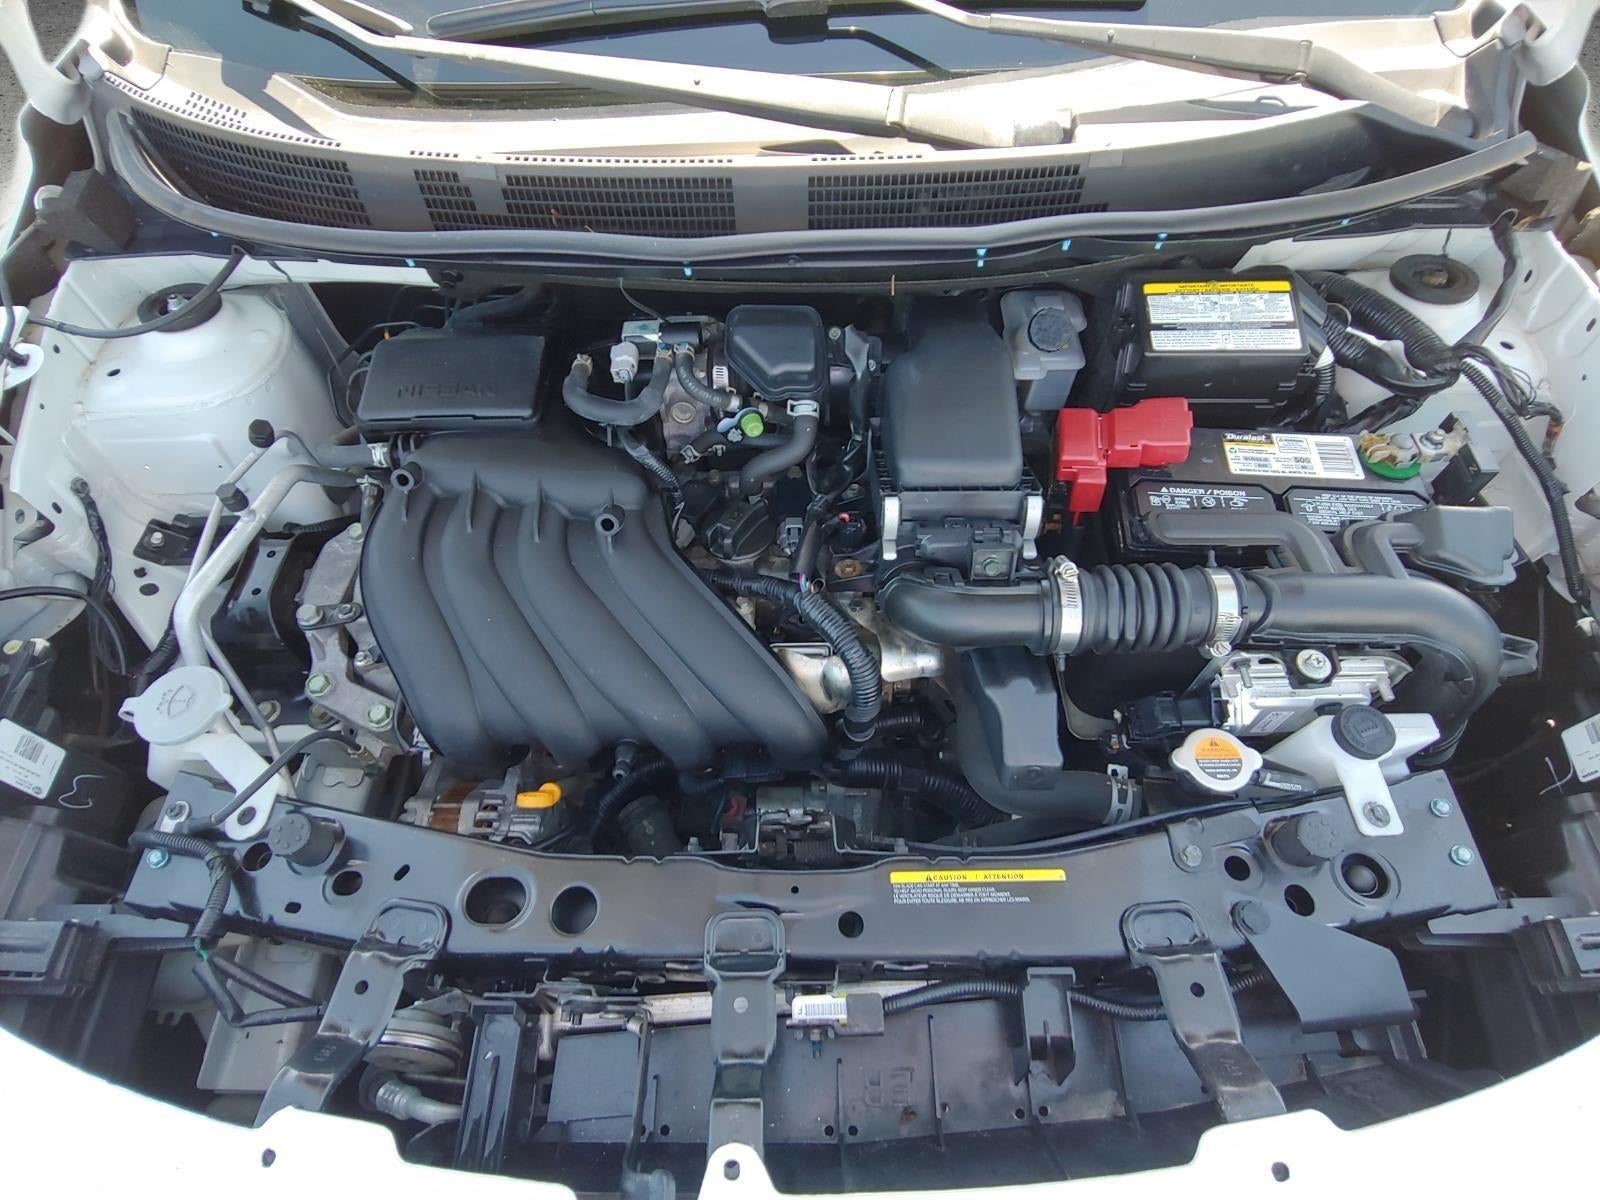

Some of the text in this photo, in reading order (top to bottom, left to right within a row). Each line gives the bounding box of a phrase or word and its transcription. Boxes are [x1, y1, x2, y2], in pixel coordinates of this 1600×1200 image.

[398, 383, 496, 398] NISSAN
[1169, 487, 1205, 495] DANGER
[933, 873, 967, 881] CAUTION
[983, 872, 1024, 880] ATTENTION
